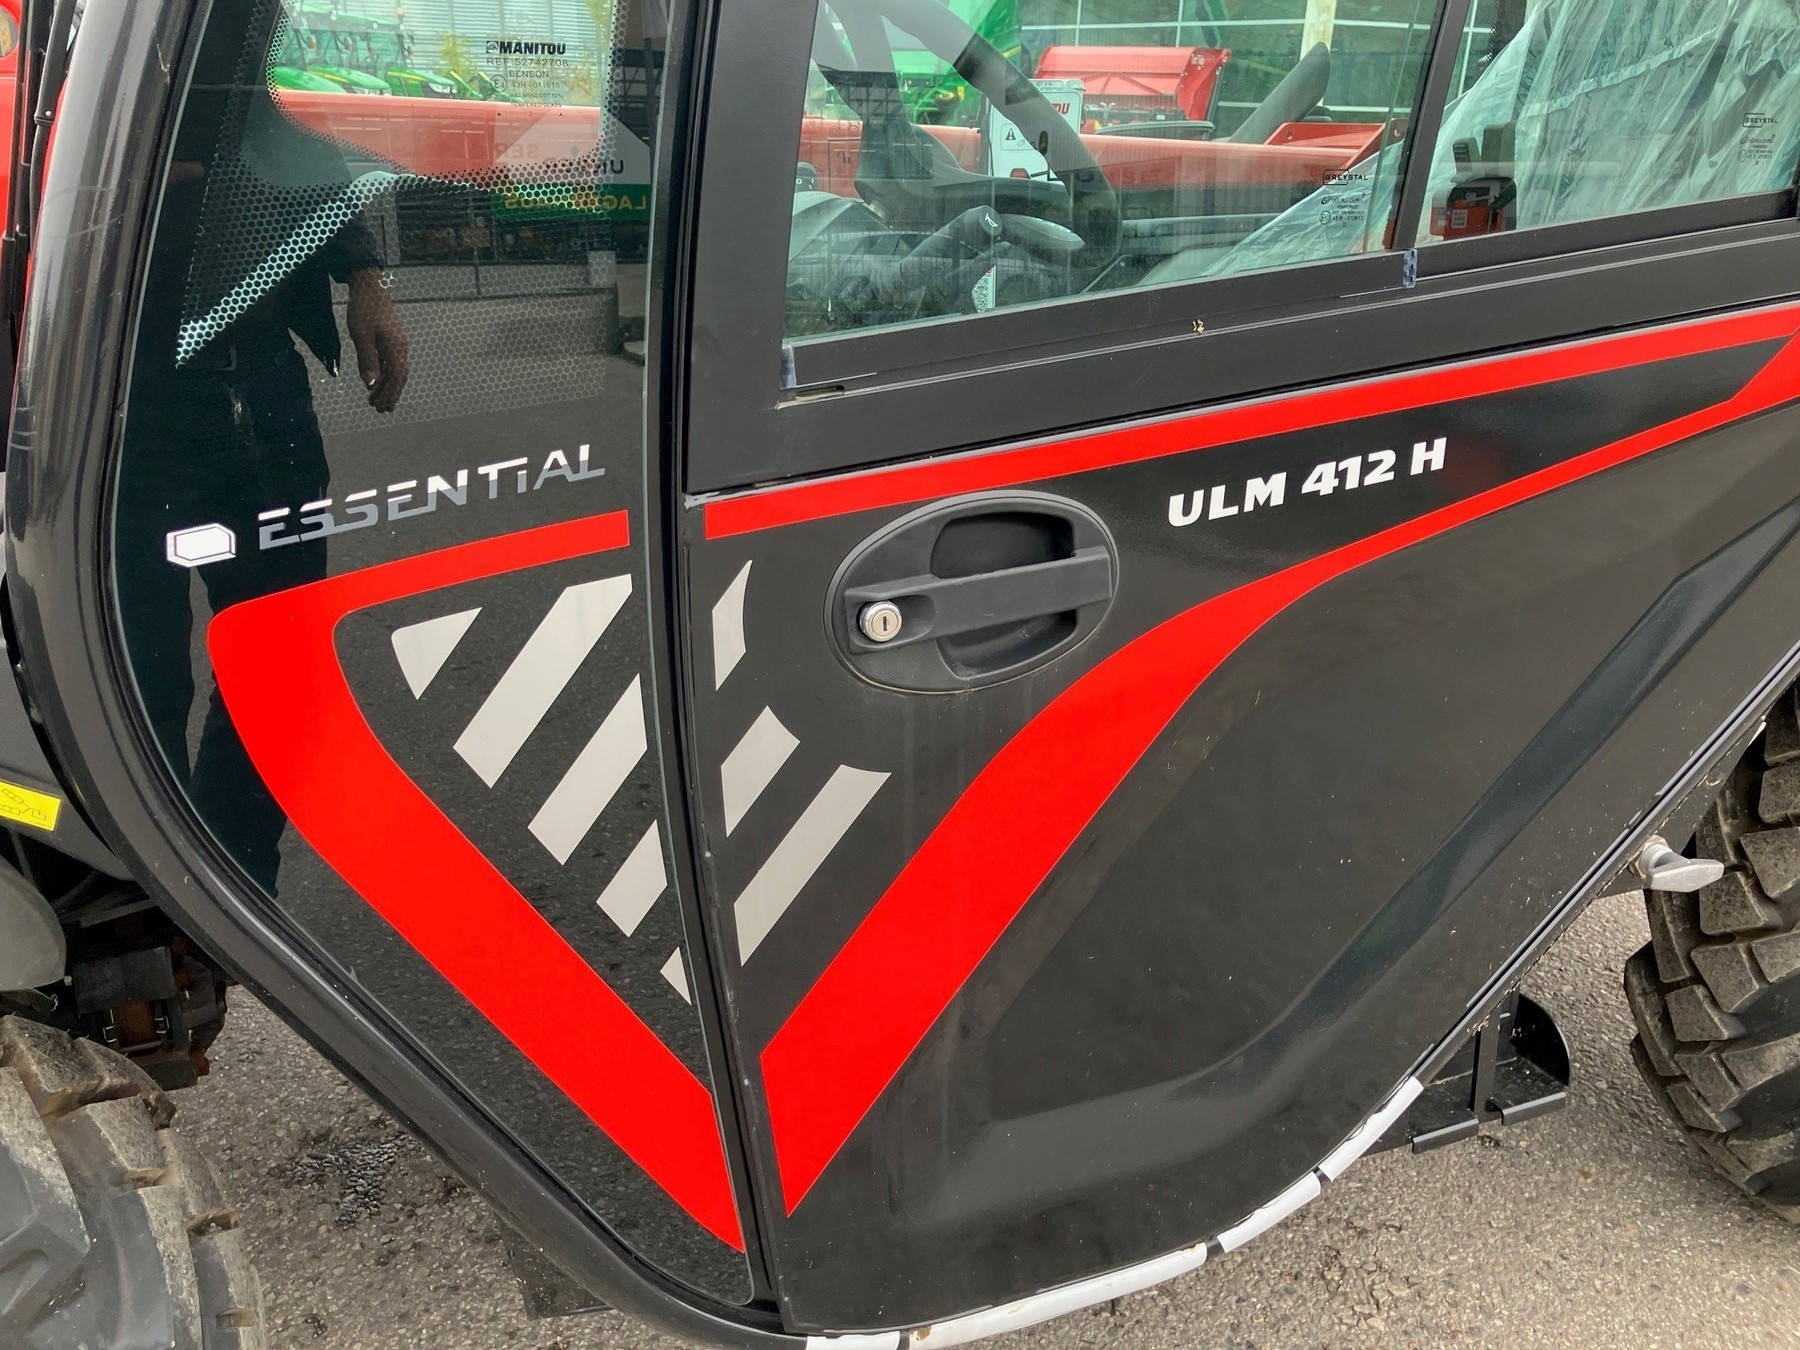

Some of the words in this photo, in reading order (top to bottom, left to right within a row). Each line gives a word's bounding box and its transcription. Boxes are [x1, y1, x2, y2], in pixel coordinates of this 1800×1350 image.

[499, 41, 566, 55] MANITOU
[257, 443, 606, 551] ESSENTIAL
[1168, 472, 1287, 527] ULM
[1301, 449, 1397, 496] 412
[1410, 437, 1447, 476] H
